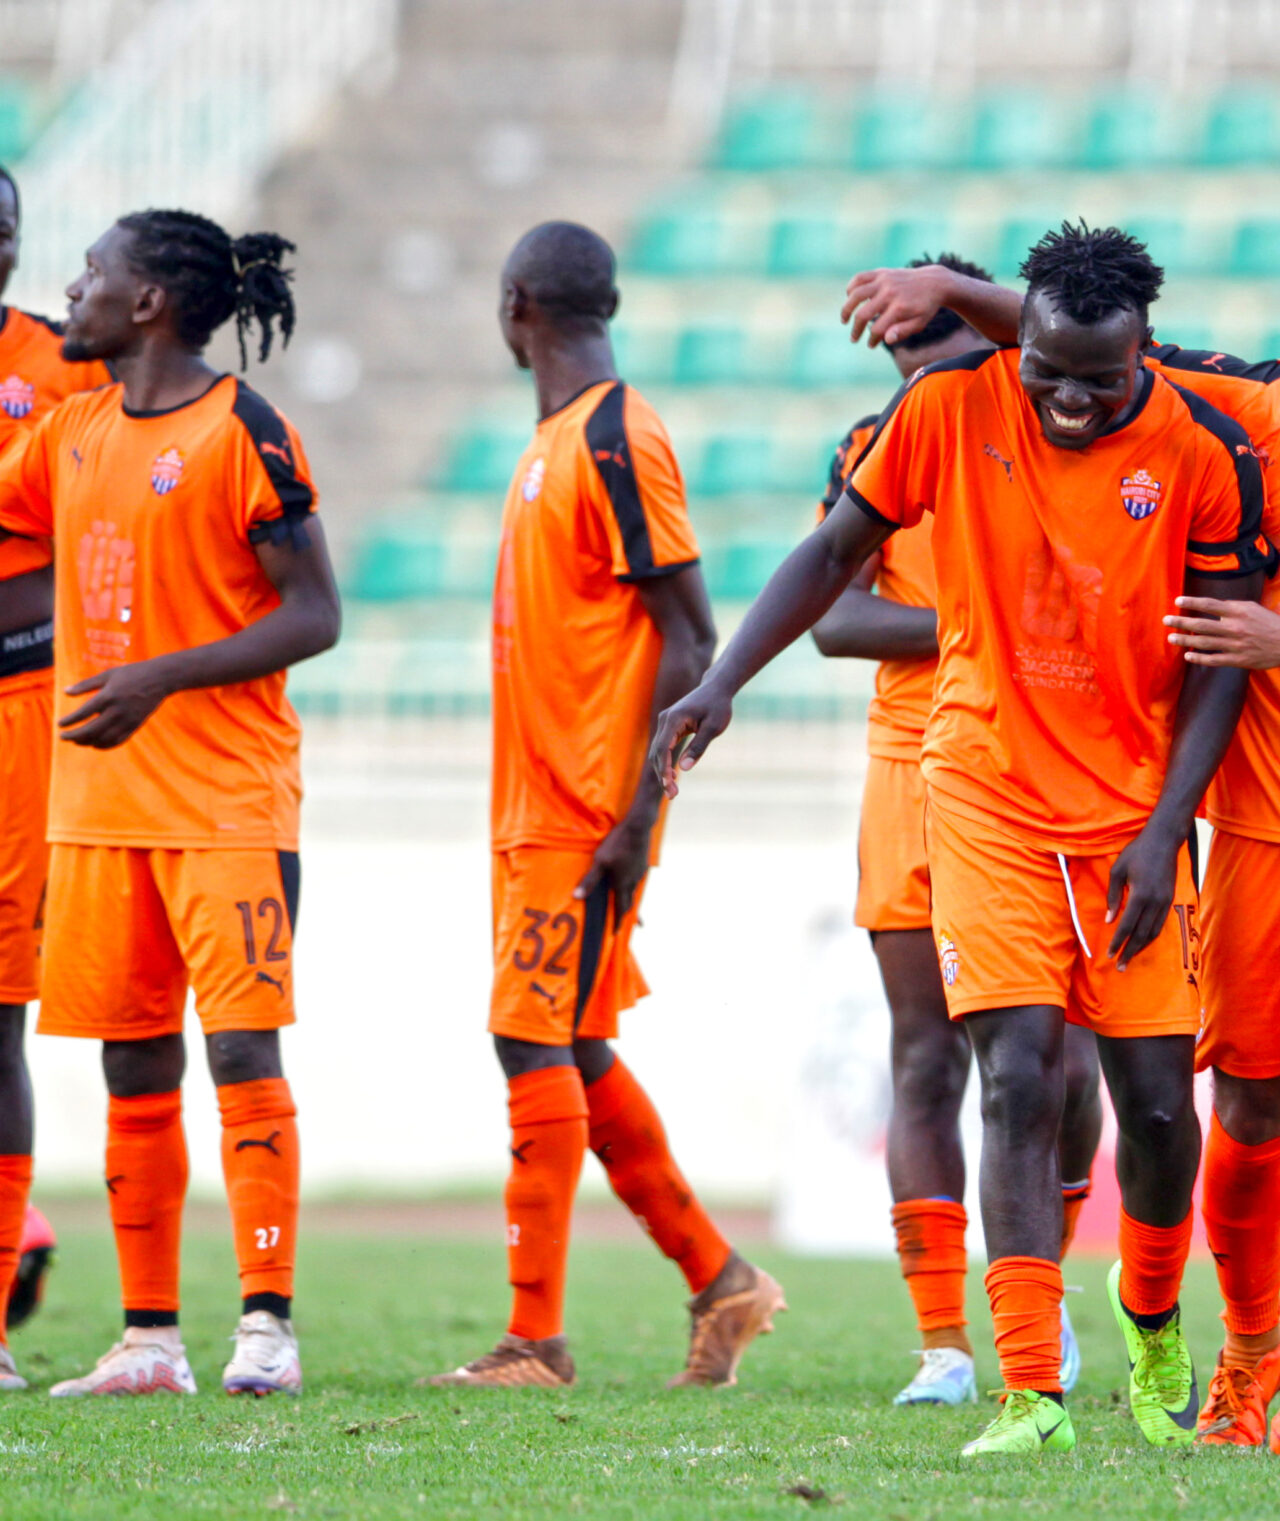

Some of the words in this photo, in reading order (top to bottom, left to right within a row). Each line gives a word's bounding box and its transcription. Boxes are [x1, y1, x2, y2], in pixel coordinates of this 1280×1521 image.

[1020, 658, 1095, 680] JACKSON
[235, 897, 288, 965] 12
[513, 907, 578, 976] 32
[253, 1226, 281, 1249] 27
